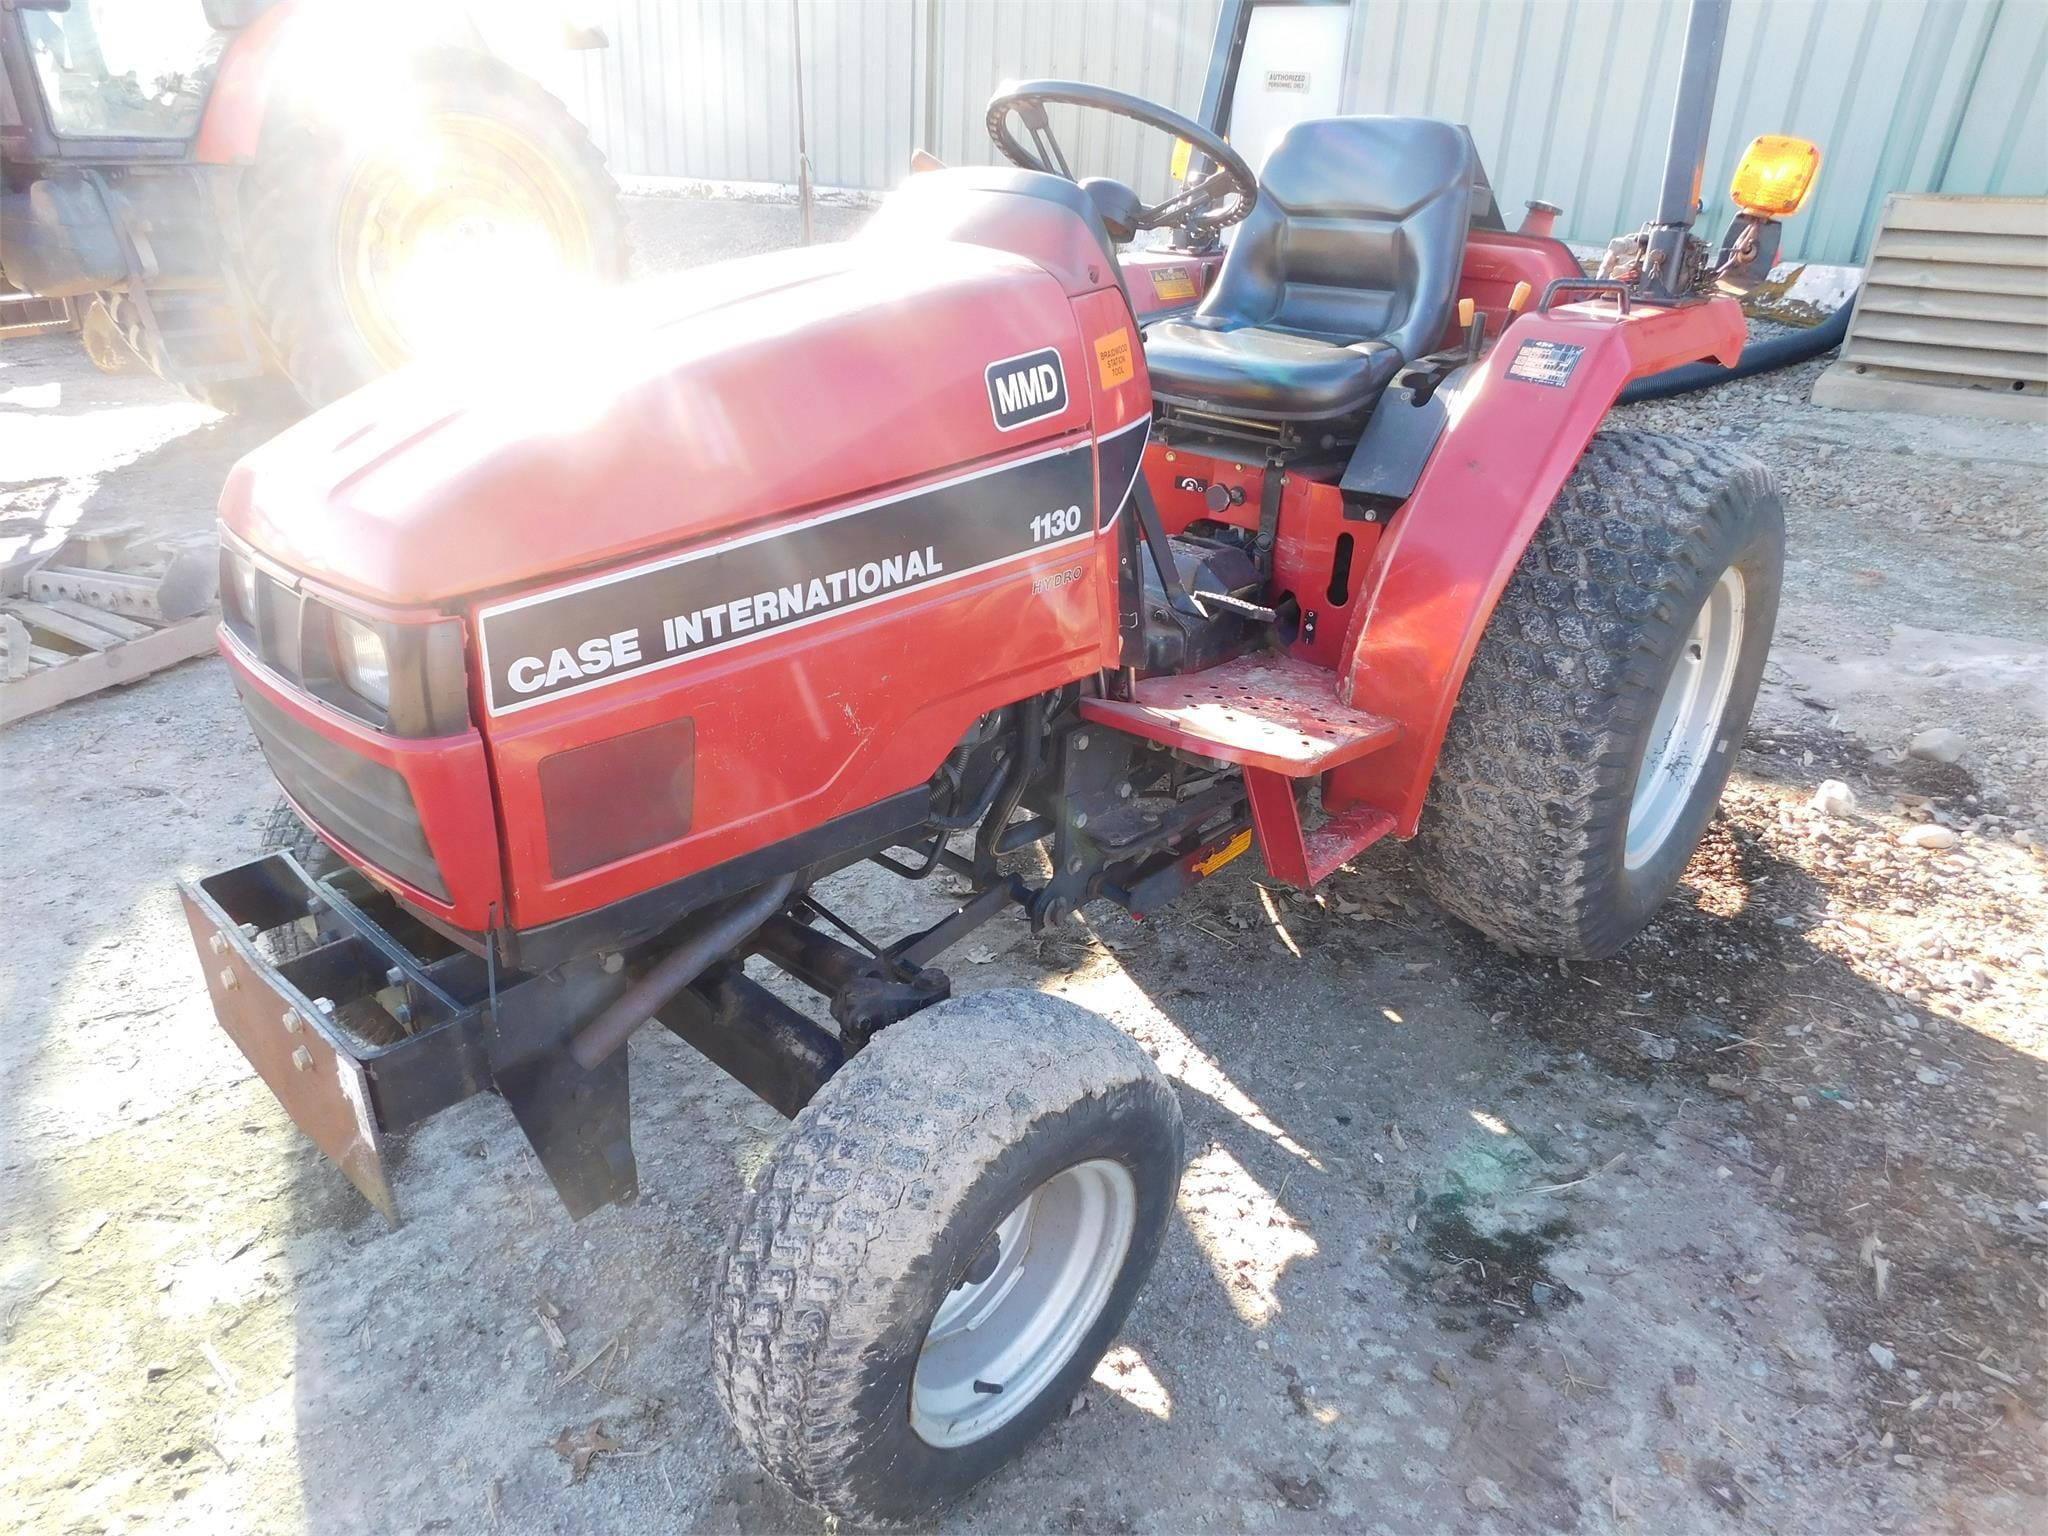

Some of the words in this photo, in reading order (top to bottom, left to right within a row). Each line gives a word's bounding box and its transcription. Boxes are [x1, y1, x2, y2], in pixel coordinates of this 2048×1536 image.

[1269, 73, 1306, 82] AUTHORIZED
[1111, 366, 1124, 377] TOOL
[995, 363, 1058, 415] MMD
[1030, 505, 1081, 543] 1130
[1031, 567, 1082, 596] HYDRO
[507, 629, 642, 693] CASE
[662, 546, 942, 652] INTERNATIONAL
